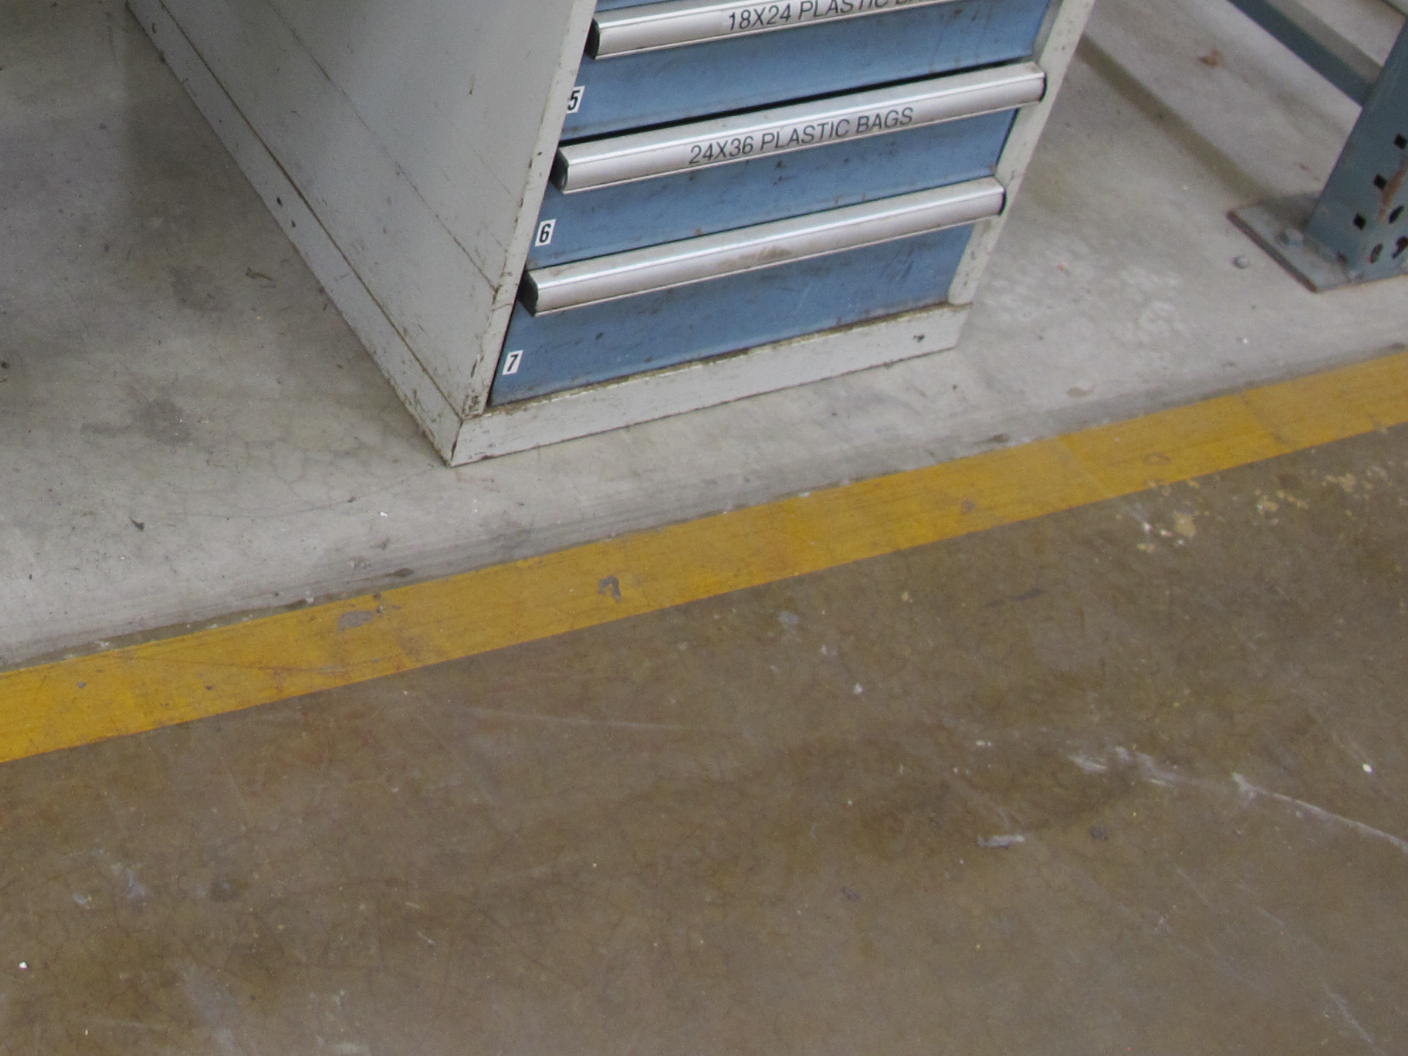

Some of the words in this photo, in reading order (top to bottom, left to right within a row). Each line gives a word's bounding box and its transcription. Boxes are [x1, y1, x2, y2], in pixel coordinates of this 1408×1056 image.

[728, 3, 792, 31] 18X24
[567, 90, 580, 112] 5
[688, 136, 754, 165] 24X36
[760, 119, 851, 151] PLASTIC
[856, 107, 914, 134] BAGS
[539, 223, 552, 244] 6
[507, 354, 520, 373] 7
